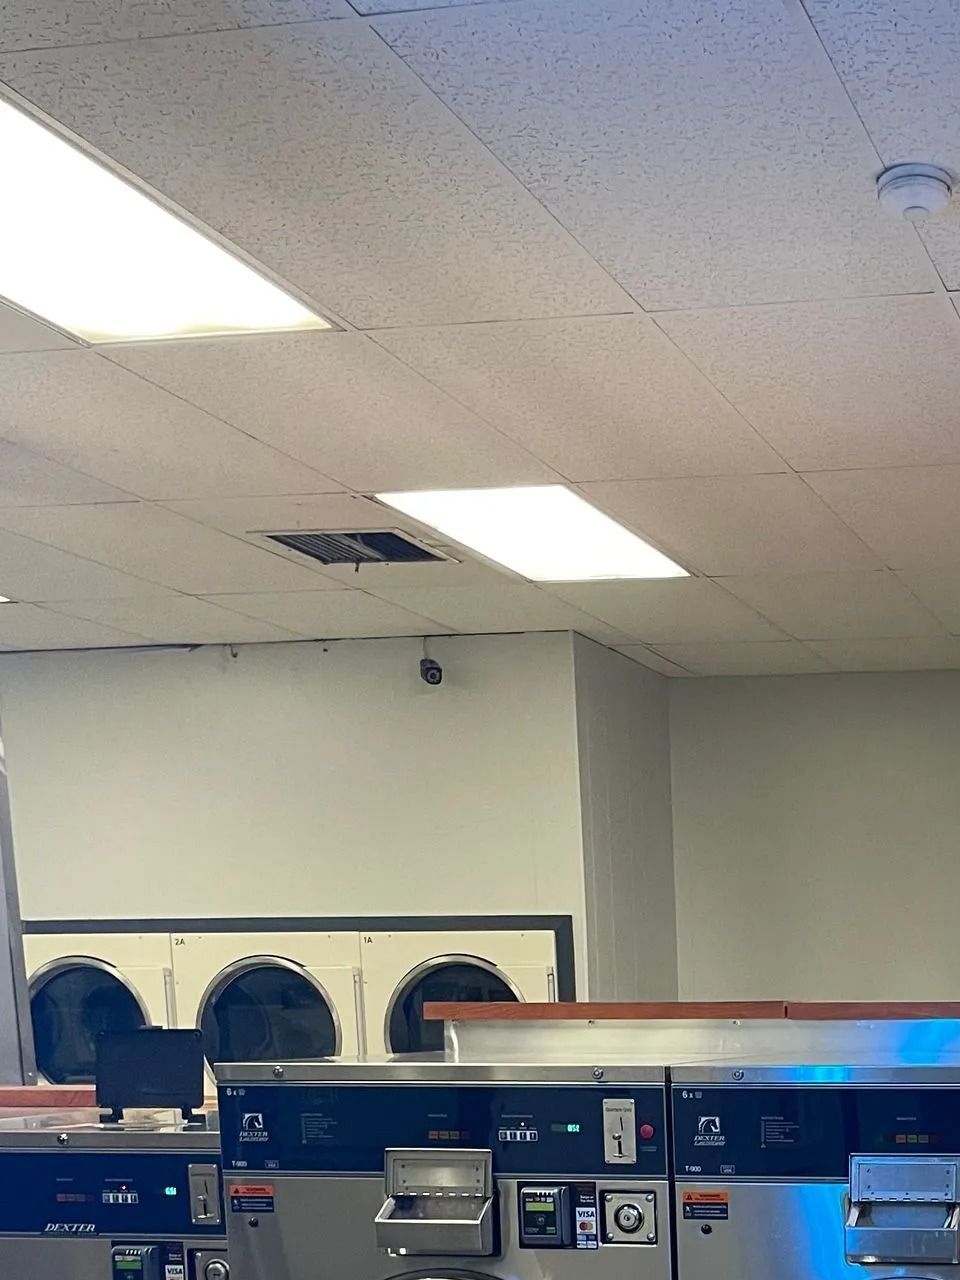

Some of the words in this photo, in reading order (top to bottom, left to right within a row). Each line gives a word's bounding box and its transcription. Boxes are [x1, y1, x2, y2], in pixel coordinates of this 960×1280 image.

[174, 938, 186, 946] 2A
[226, 1088, 232, 1096] 6
[682, 1090, 688, 1099] 6
[578, 1210, 595, 1218] VISA
[44, 1223, 96, 1232] DEXTER
[167, 1267, 183, 1275] VISA
